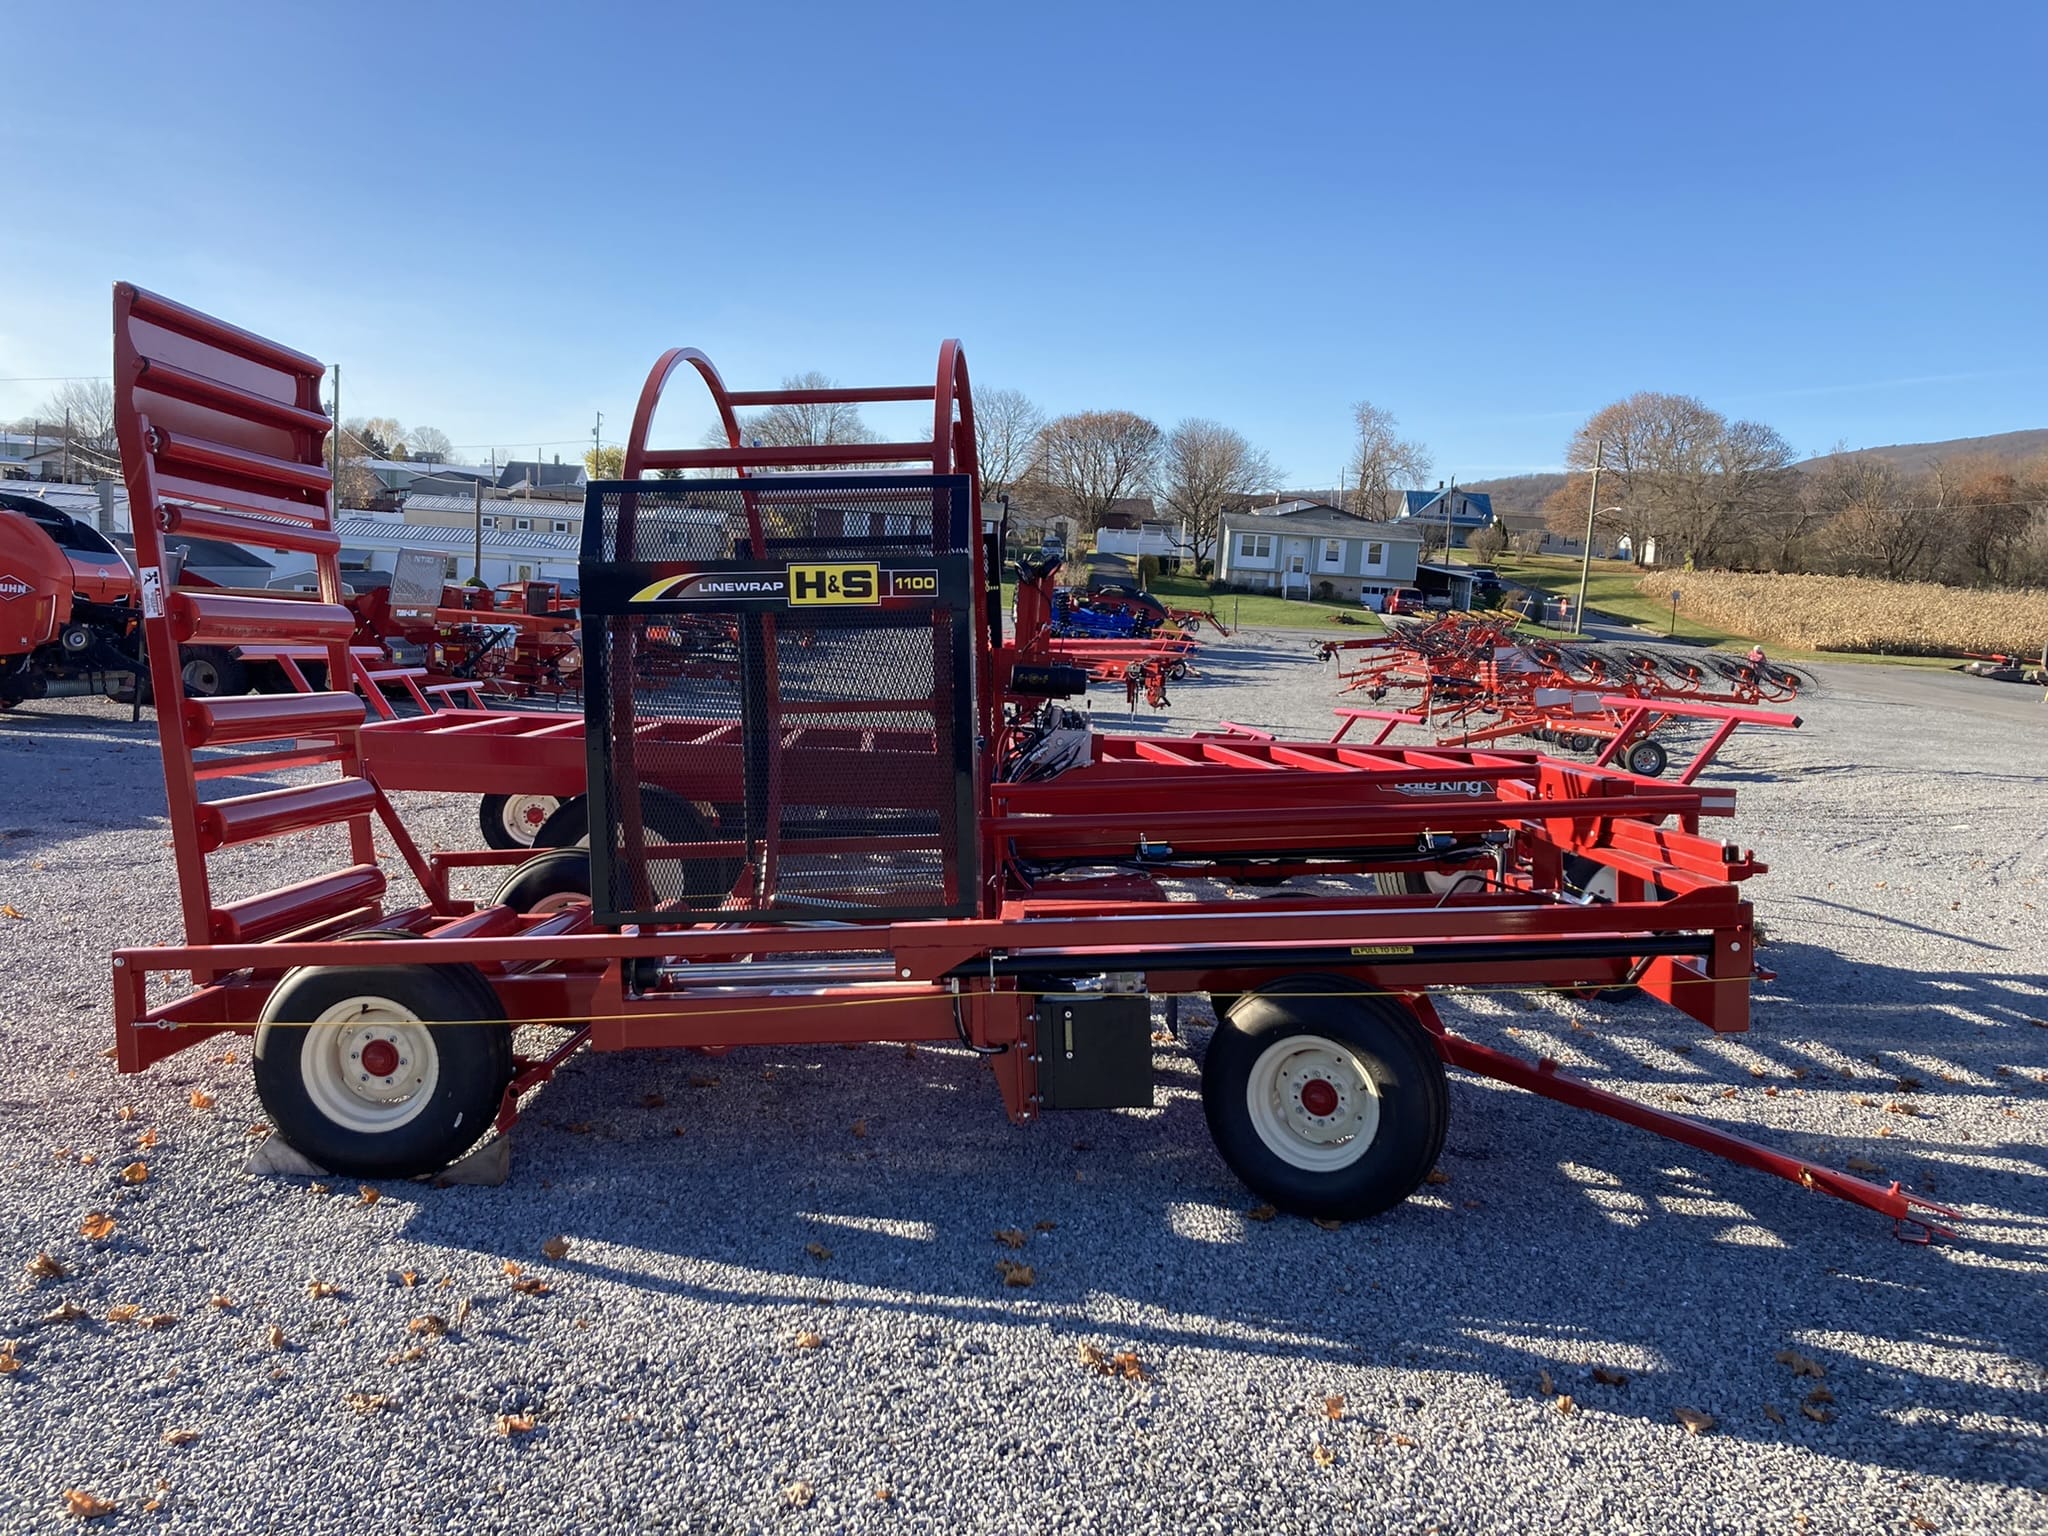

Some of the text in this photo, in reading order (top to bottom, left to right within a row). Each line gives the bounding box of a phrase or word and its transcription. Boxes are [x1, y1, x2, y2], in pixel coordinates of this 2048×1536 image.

[699, 570, 935, 599] LINEWRAP H&S 1100
